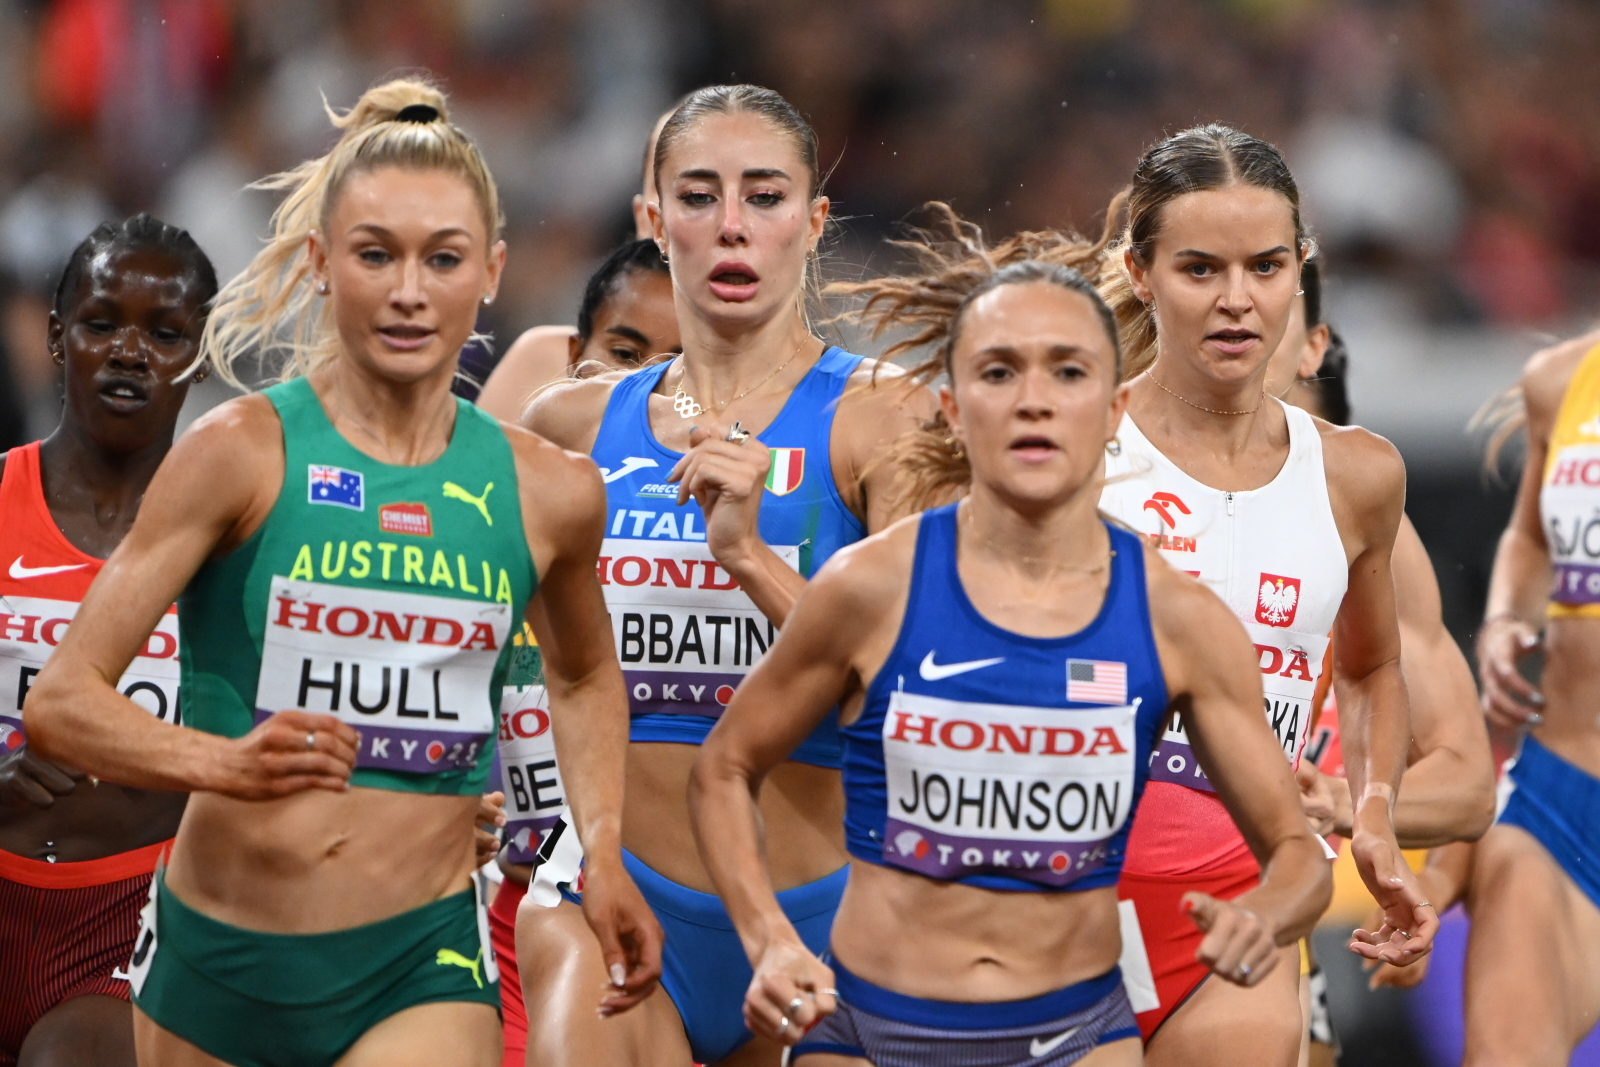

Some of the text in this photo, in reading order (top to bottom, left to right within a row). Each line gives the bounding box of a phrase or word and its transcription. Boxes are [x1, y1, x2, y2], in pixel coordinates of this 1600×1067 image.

[610, 509, 706, 541] ITAL
[289, 540, 512, 605] AUSTRALIA
[273, 596, 499, 651] HONDA
[297, 658, 459, 721] HULL
[889, 710, 1128, 757] HONDA
[899, 769, 1120, 832] JOHNSON
